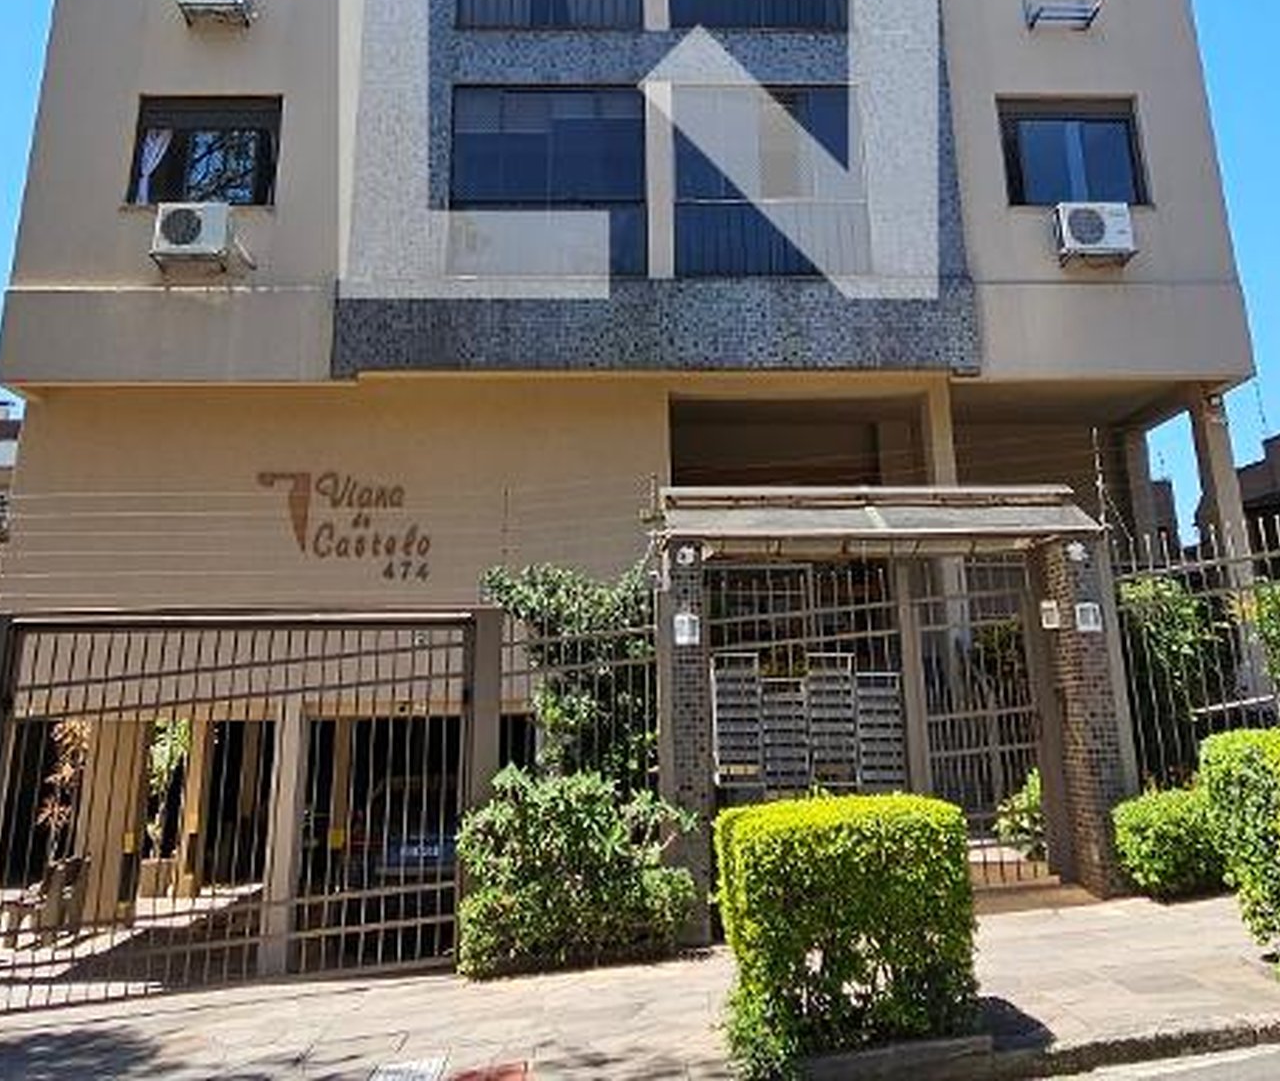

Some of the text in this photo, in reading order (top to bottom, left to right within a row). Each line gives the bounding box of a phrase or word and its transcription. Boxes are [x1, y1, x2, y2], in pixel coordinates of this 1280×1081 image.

[315, 471, 405, 509] Viana
[313, 522, 431, 559] Castelo
[383, 561, 429, 581] 474
